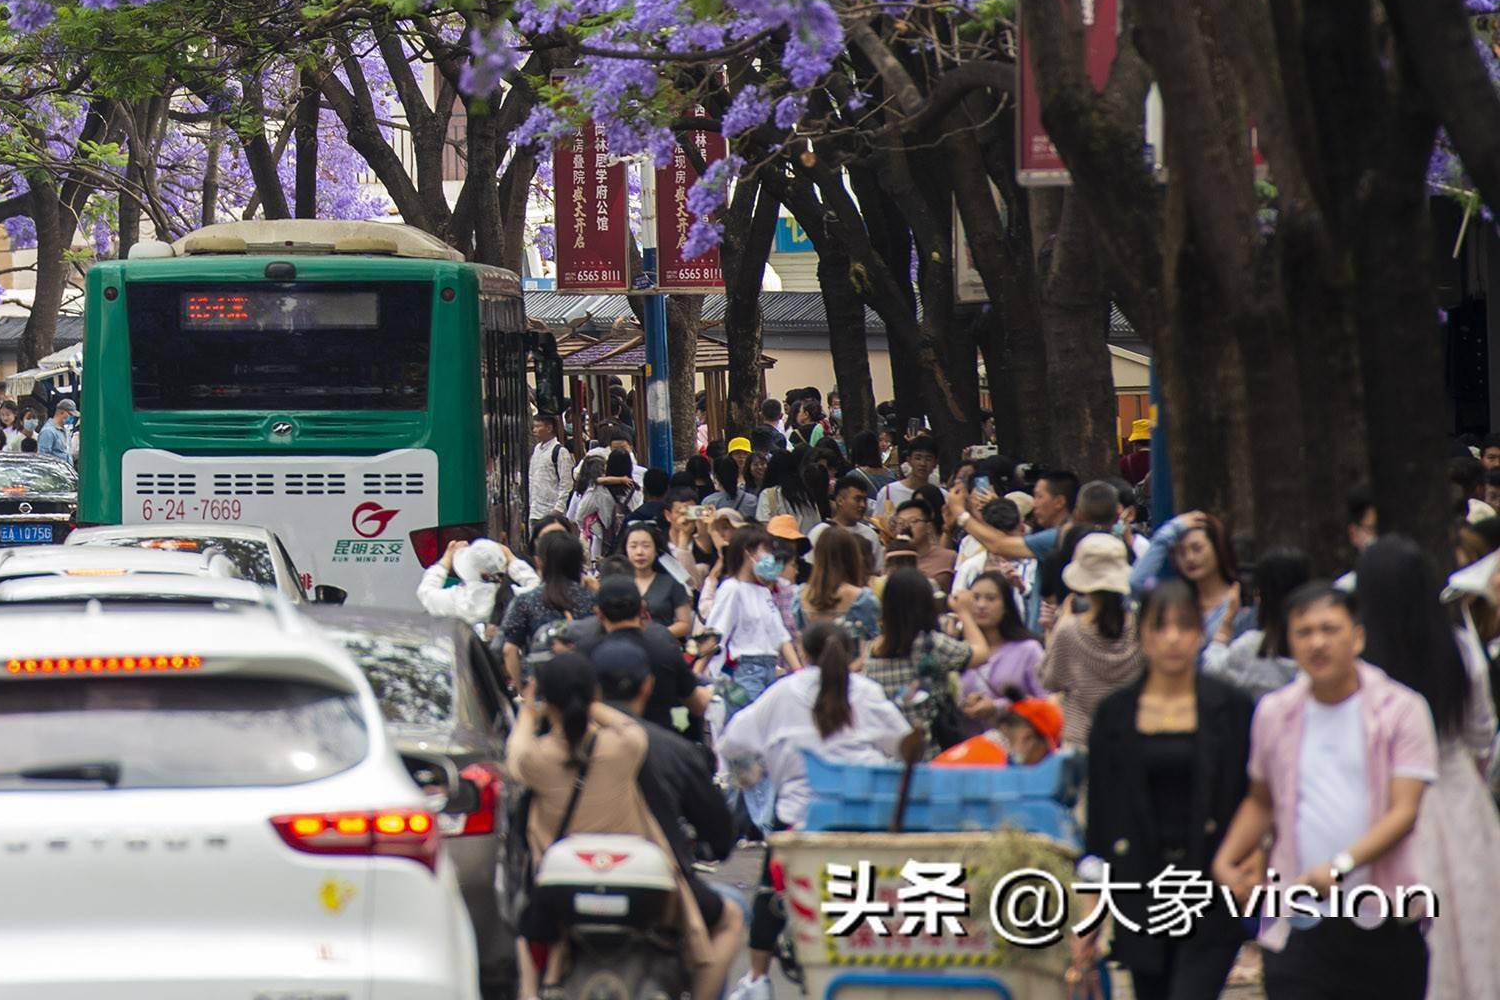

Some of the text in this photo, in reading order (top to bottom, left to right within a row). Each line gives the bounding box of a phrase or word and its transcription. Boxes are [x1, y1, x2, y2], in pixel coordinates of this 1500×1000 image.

[577, 270, 599, 281] 6565
[601, 269, 621, 281] 8111
[678, 268, 701, 280] 6565
[333, 540, 404, 556] 昆明公交
